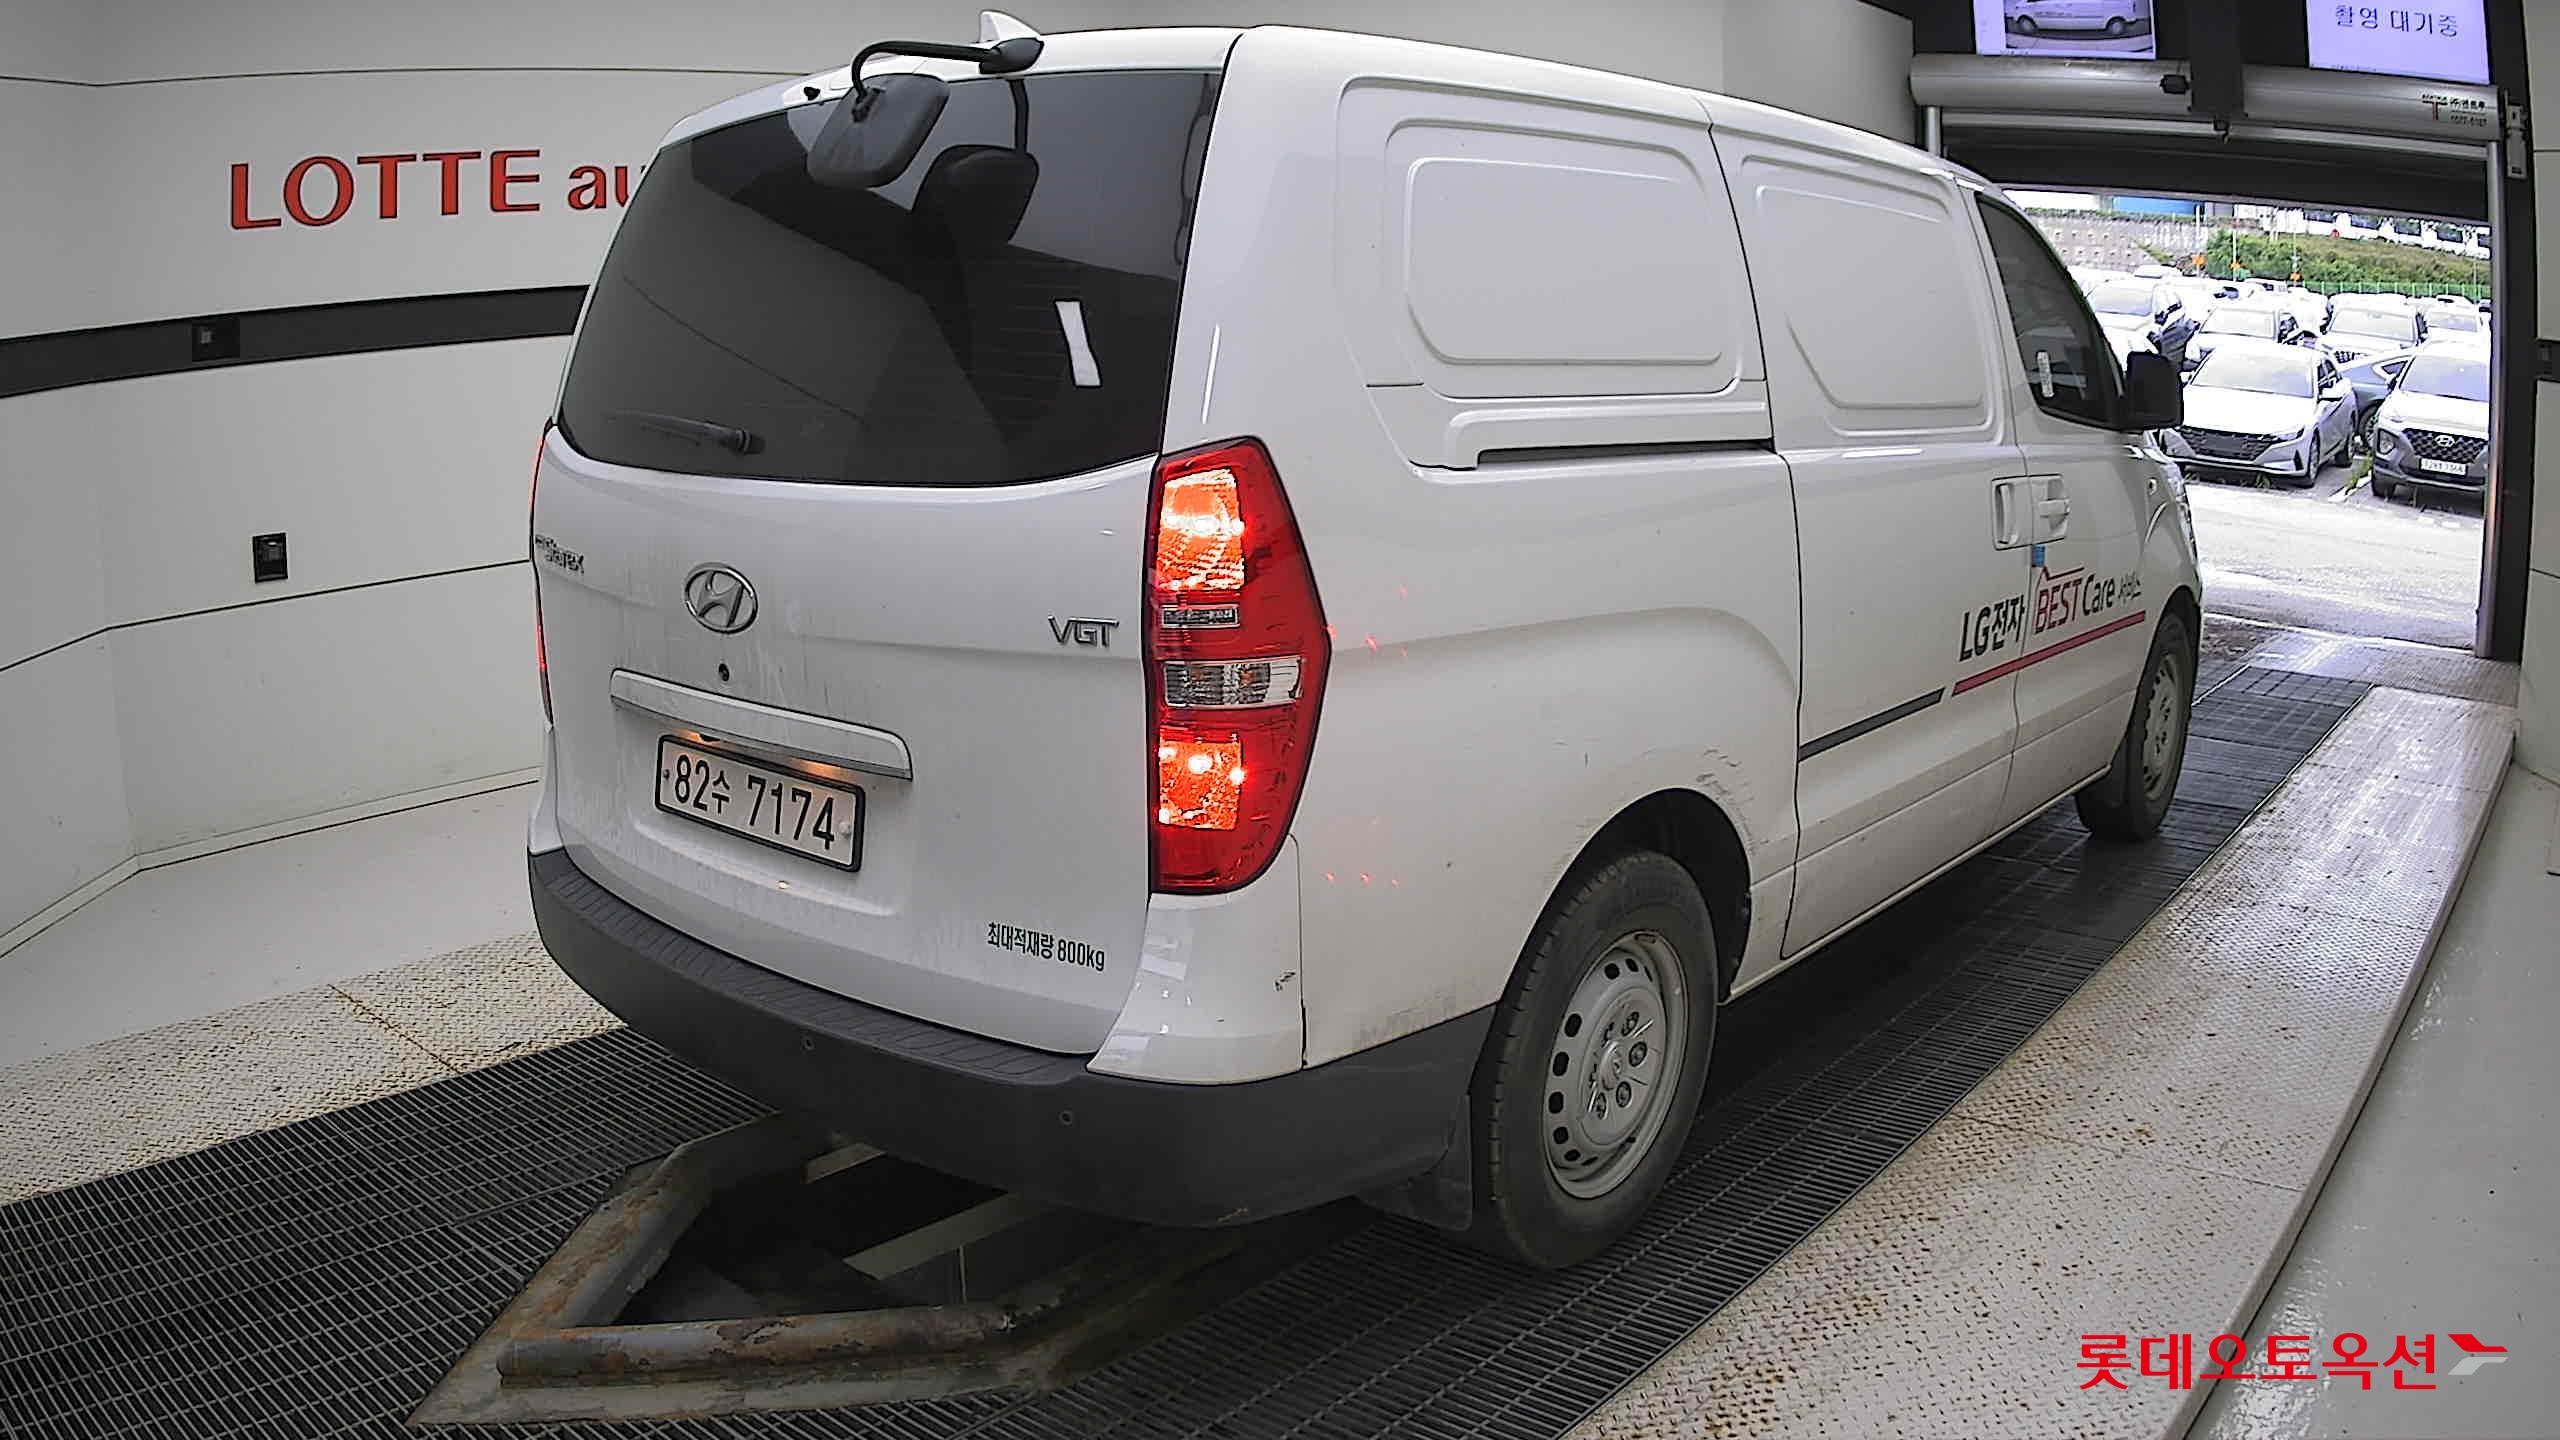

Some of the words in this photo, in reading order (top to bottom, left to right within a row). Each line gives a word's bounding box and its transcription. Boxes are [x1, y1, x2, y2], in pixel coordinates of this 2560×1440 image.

[2390, 10, 2458, 38] 대기중
[230, 149, 541, 231] LOTTE
[1047, 615, 1120, 648] VGT
[1959, 595, 2025, 661] LG전자
[2034, 577, 2083, 635] BEST
[2082, 574, 2116, 617] Care
[674, 754, 731, 814] 82수
[748, 774, 835, 850] 7174
[987, 922, 1055, 960] 최대적재량
[1057, 938, 1105, 973] 800kg
